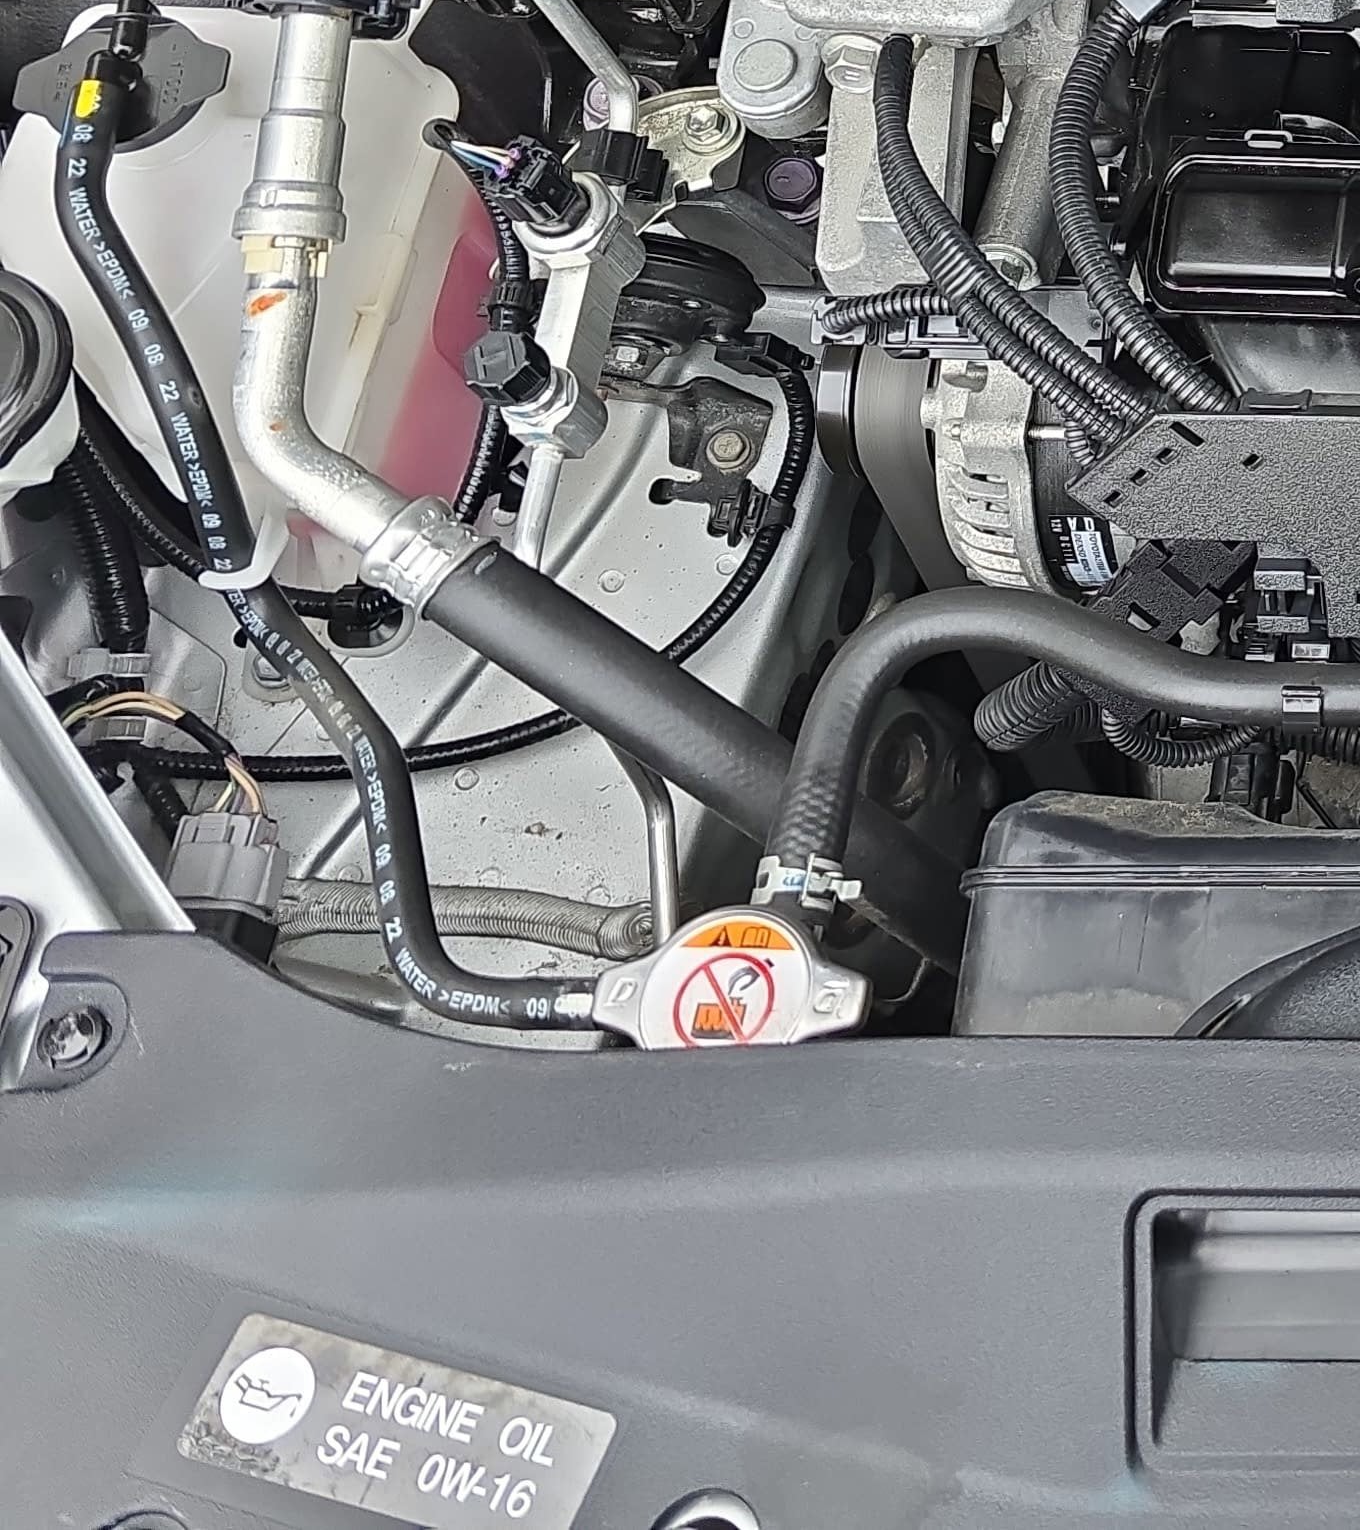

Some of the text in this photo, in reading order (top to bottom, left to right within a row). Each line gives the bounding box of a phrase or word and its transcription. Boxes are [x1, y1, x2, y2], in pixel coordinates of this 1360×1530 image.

[72, 124, 94, 143] 08
[67, 157, 88, 179] 22
[68, 186, 101, 242] WATER
[93, 241, 136, 301] >EPDM<
[143, 343, 165, 366] 08
[158, 380, 180, 404] 22
[170, 411, 198, 463] WATER
[186, 461, 214, 507] >EPDM<
[213, 557, 233, 572] 22
[384, 916, 402, 945] 22
[394, 947, 438, 1001] WATER
[437, 989, 512, 1017] >EPDM<
[342, 1371, 556, 1468] ENGINE OIL
[317, 1425, 538, 1519] SAE 0W-16
